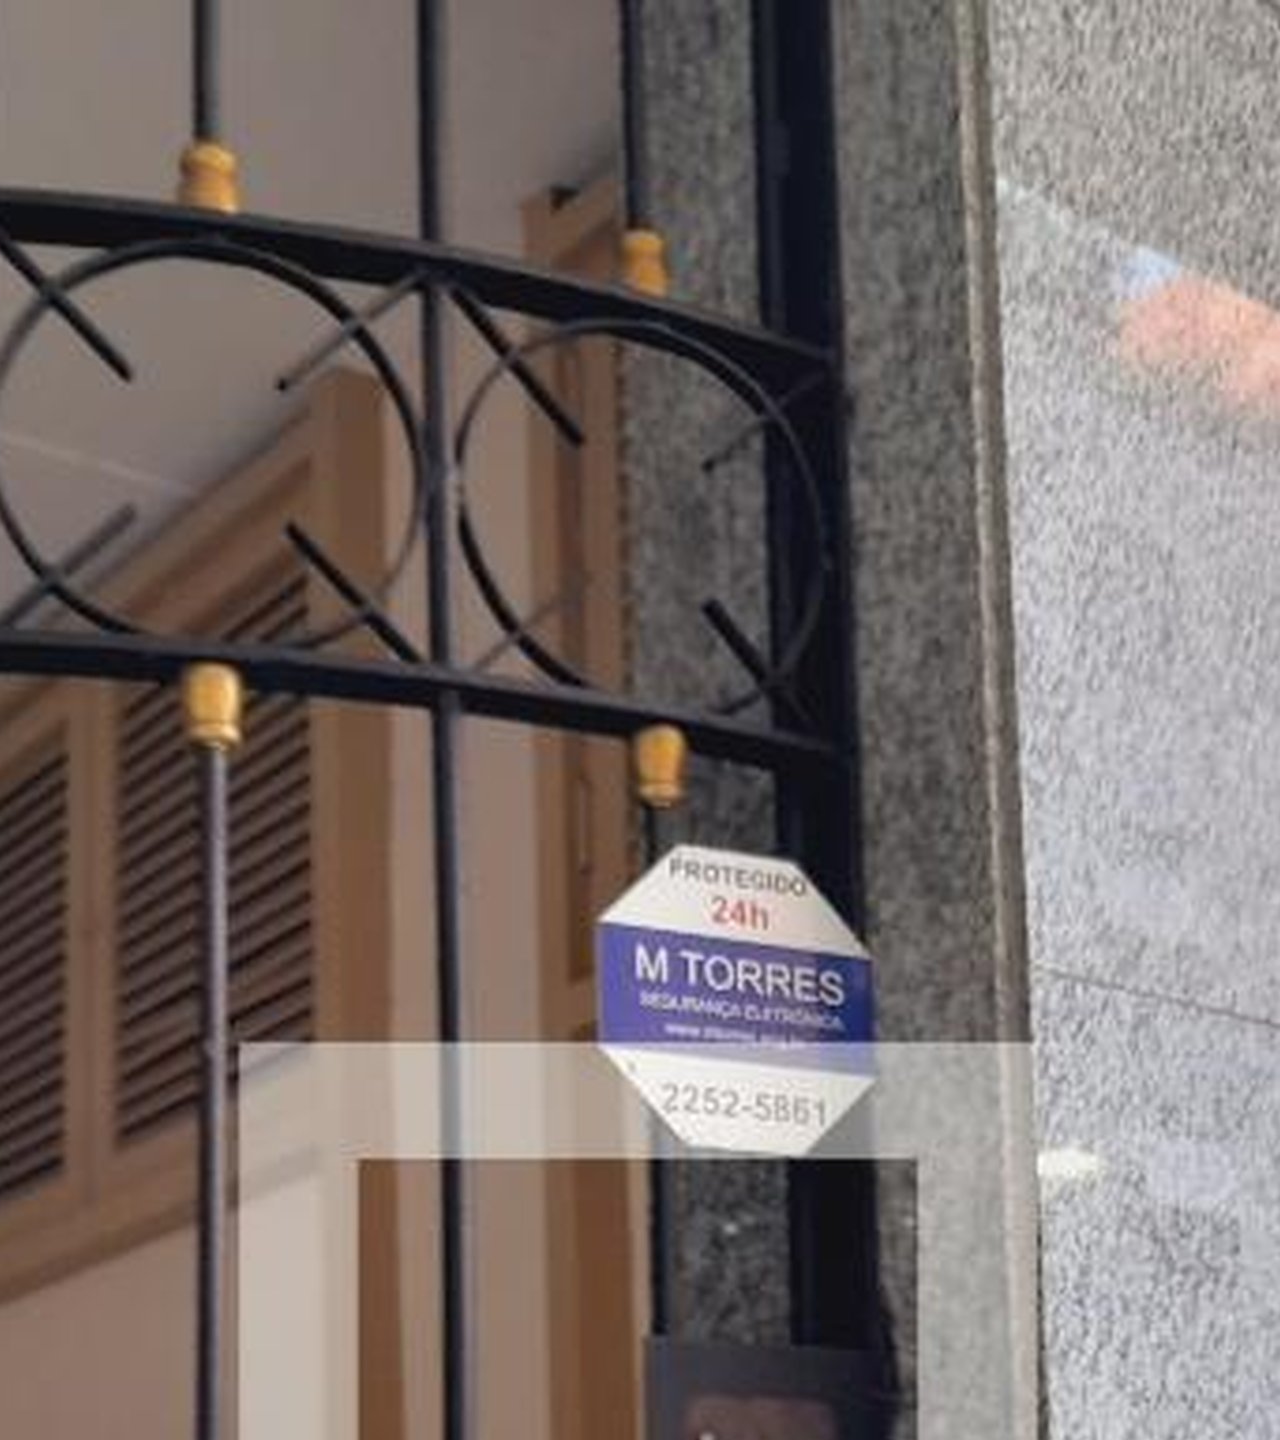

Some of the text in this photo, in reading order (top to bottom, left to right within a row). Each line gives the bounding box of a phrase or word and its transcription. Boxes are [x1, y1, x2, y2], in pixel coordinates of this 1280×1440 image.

[669, 857, 807, 897] PROTEGIDO
[710, 895, 770, 931] 24h
[634, 946, 845, 1007] M TORRES
[661, 1083, 826, 1127] 2252-5861
